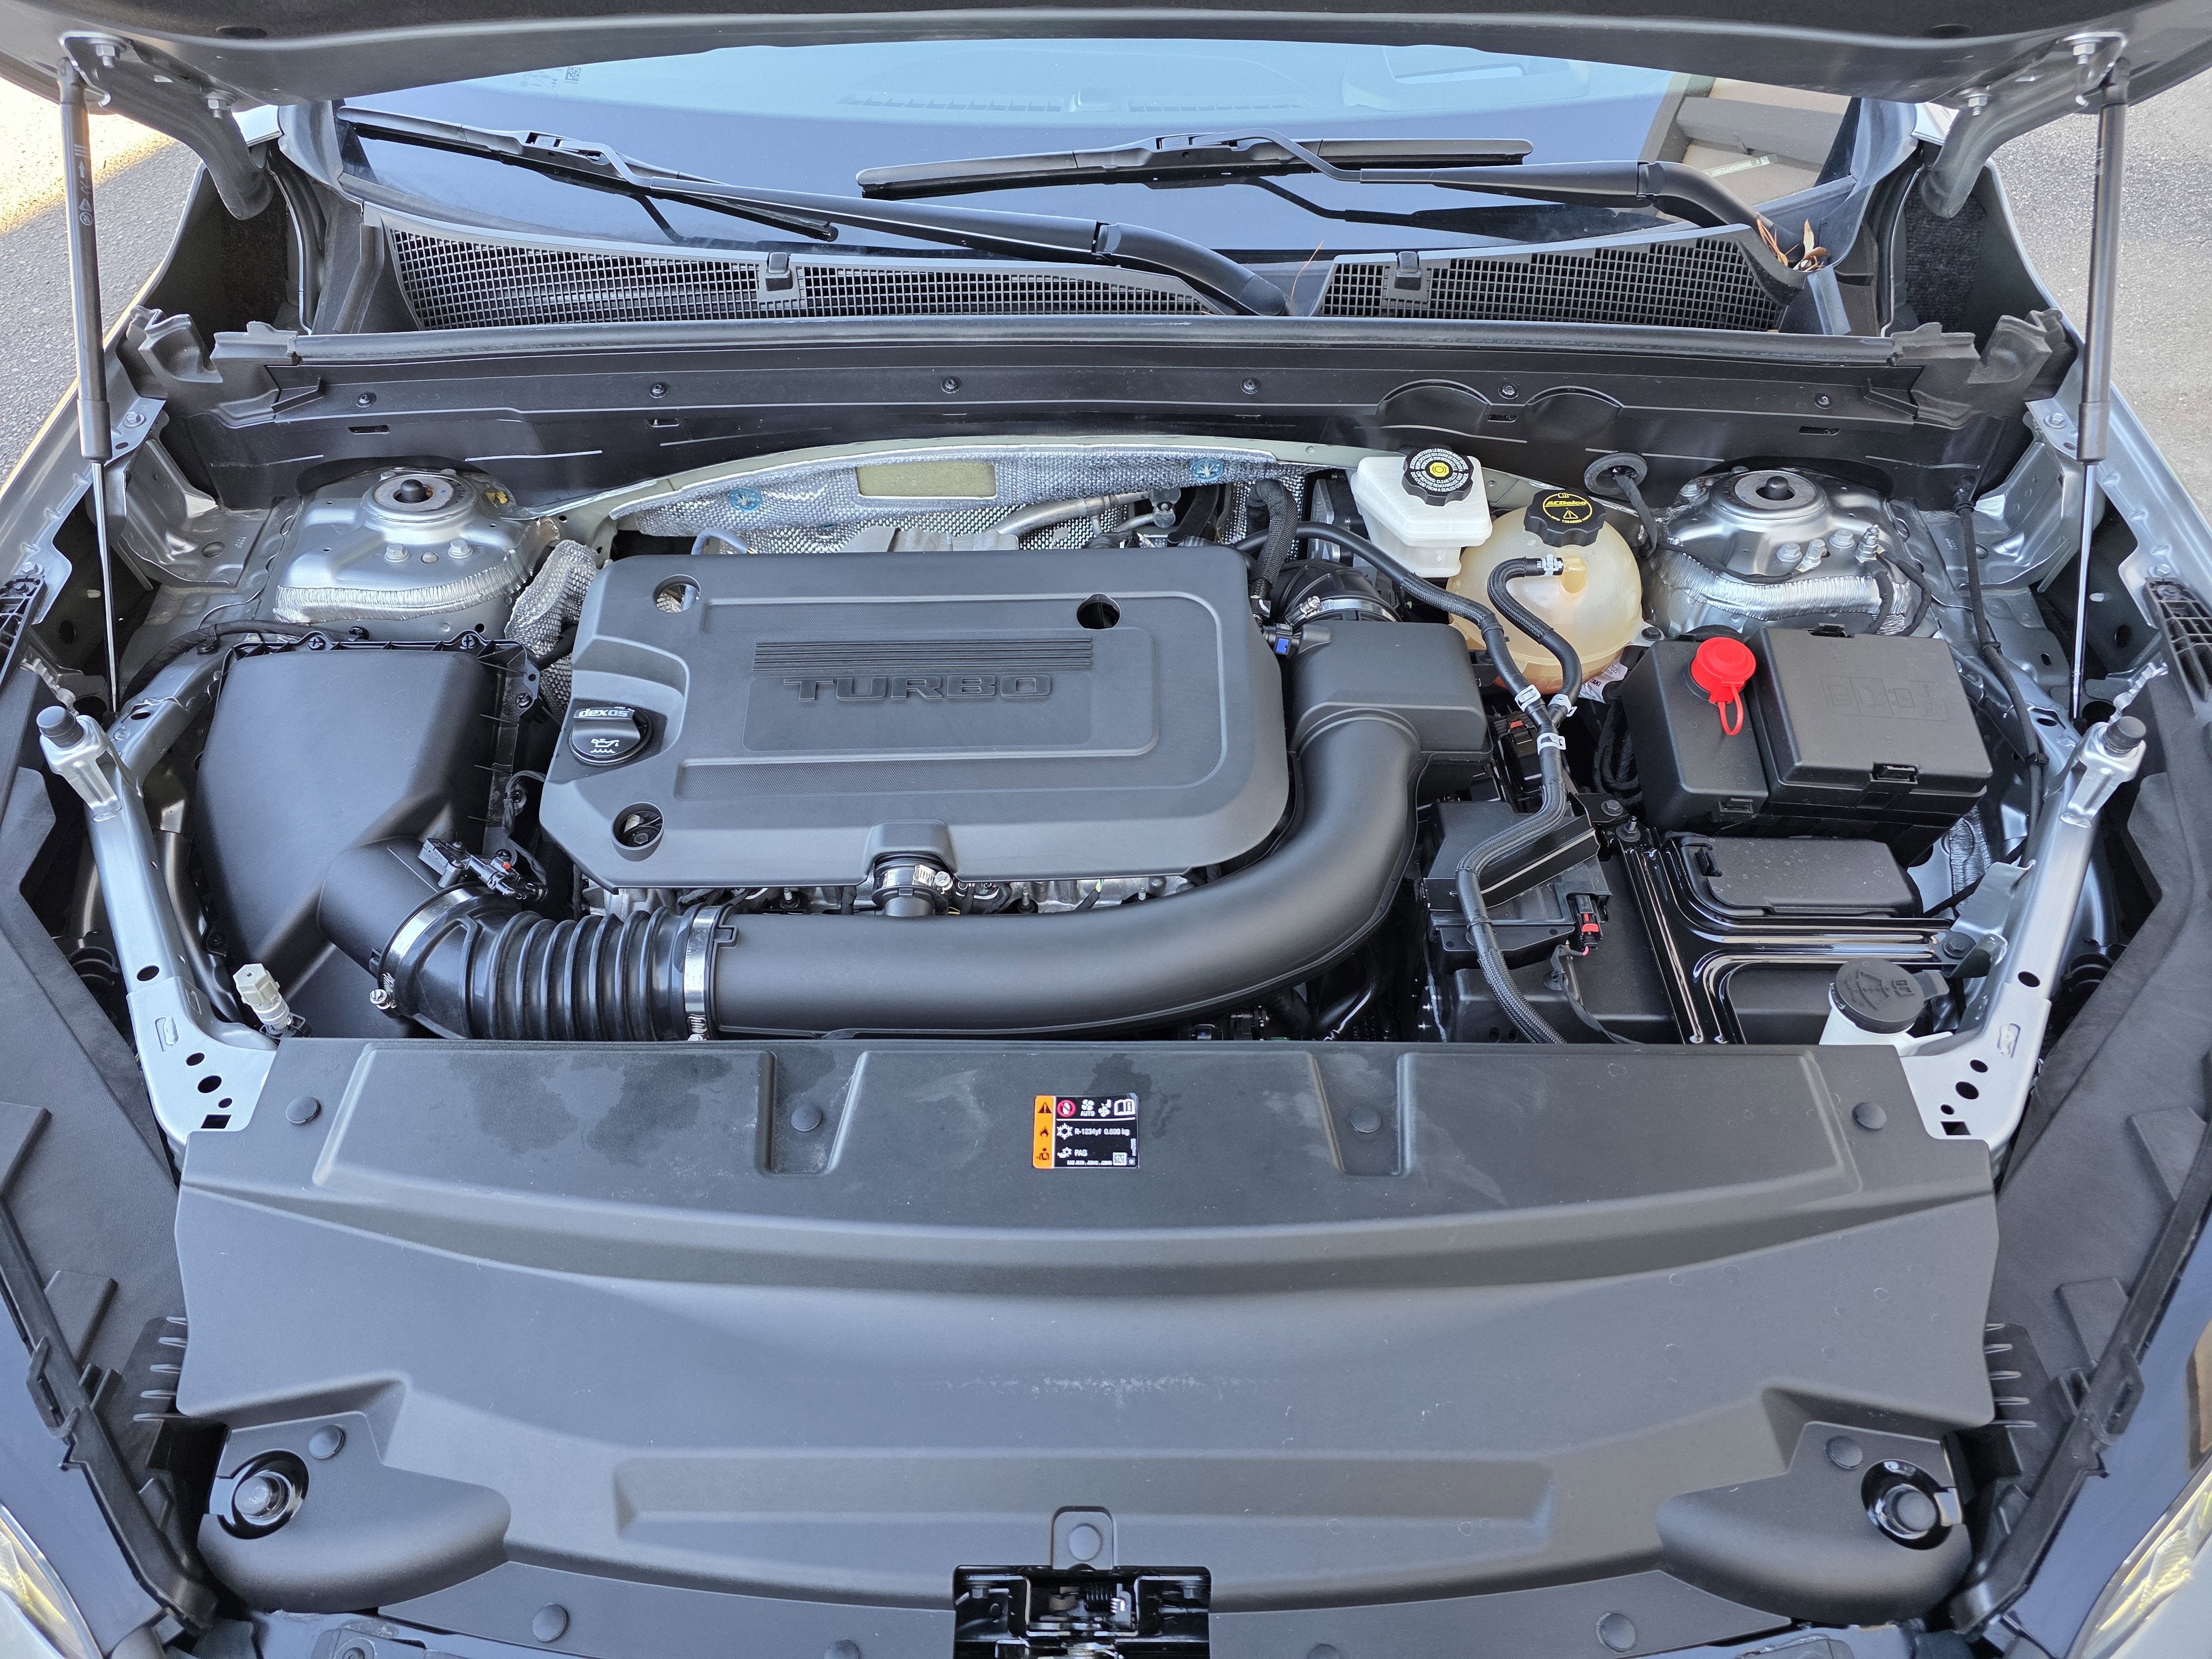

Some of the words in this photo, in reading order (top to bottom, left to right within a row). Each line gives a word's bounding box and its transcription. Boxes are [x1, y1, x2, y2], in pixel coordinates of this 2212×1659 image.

[1448, 472, 1457, 481] FILLER
[1420, 477, 1433, 487] BEFORE
[783, 675, 1051, 701] TURBO
[578, 708, 630, 717] dexos
[1074, 1128, 1102, 1136] R-1234yf
